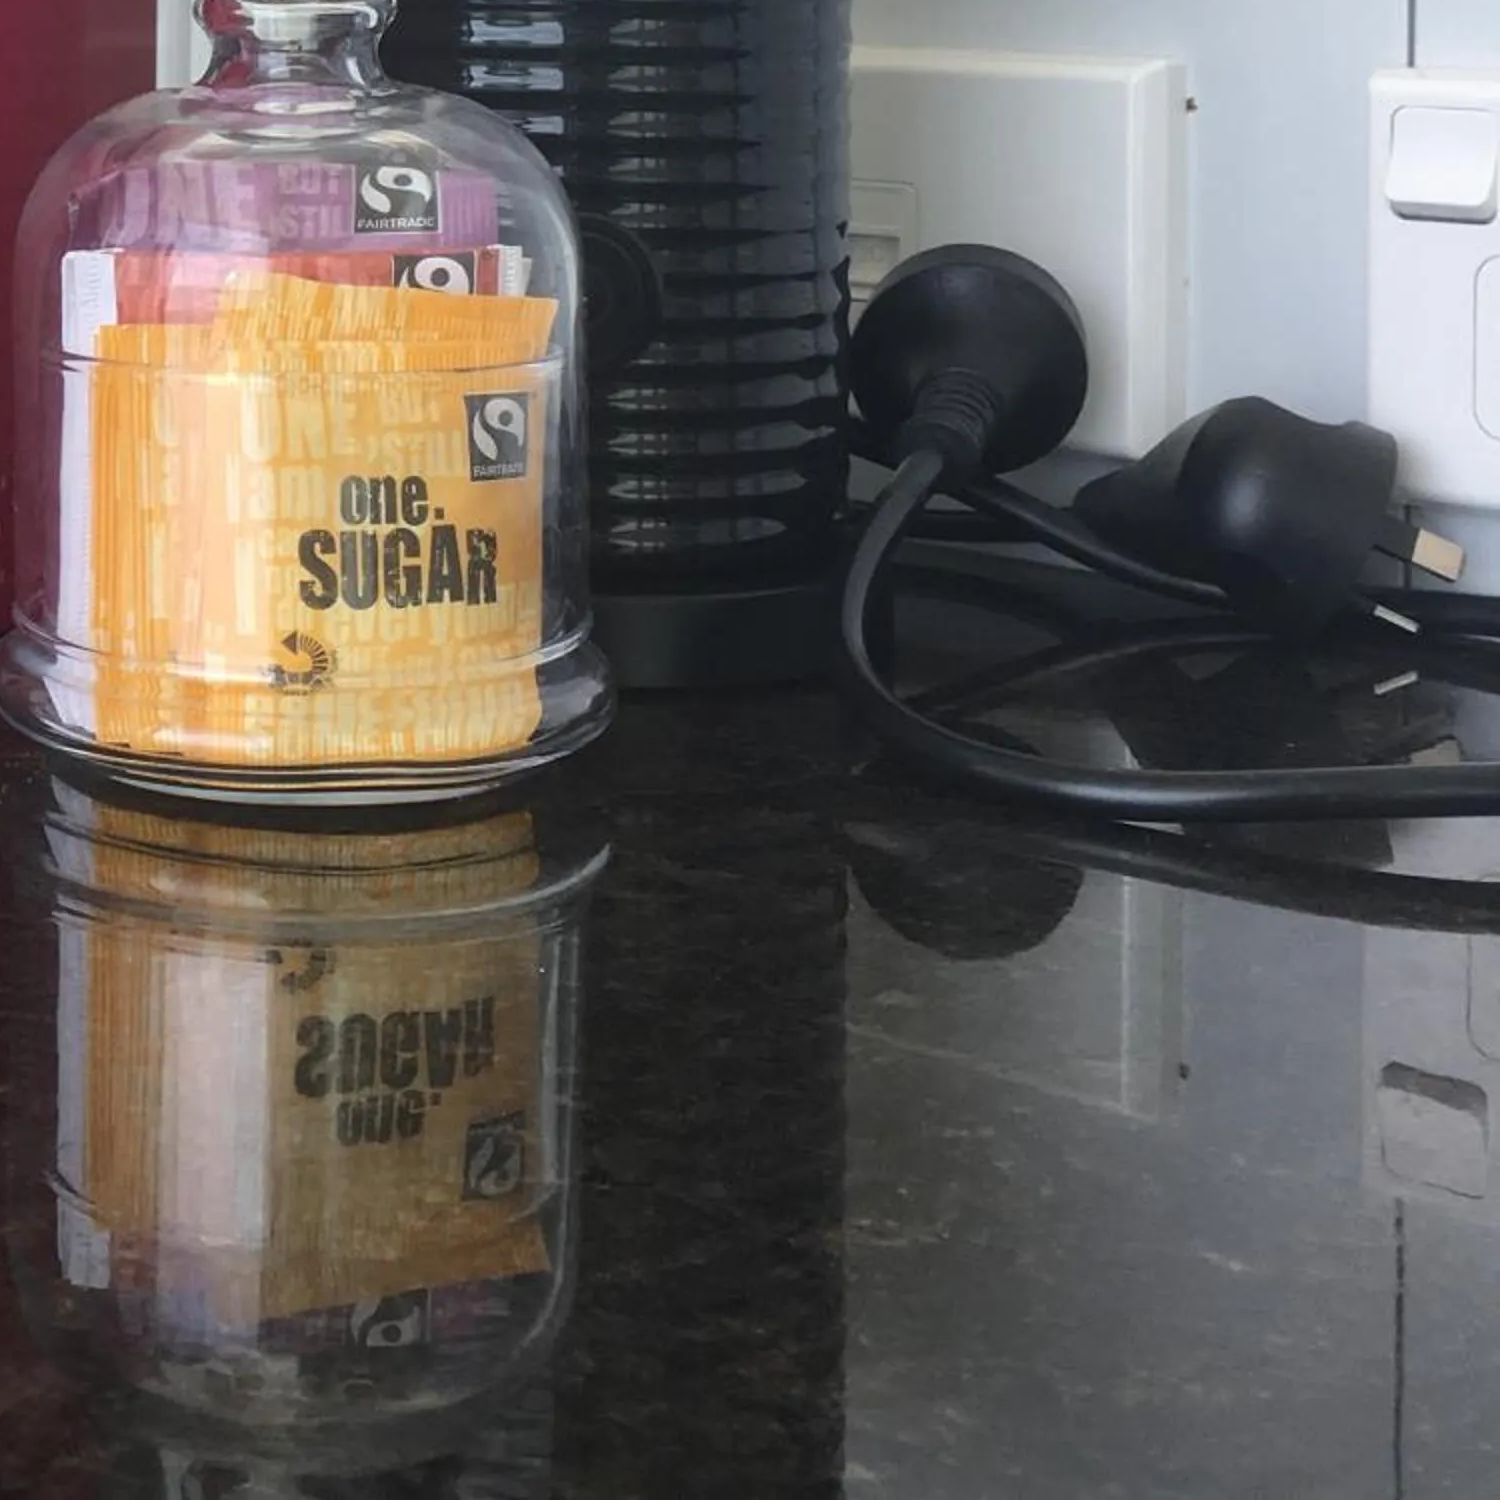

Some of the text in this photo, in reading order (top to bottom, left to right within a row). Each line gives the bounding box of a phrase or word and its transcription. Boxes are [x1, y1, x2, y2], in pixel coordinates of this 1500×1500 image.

[356, 215, 436, 230] FAIRTRADE
[339, 475, 445, 527] one.
[297, 524, 497, 611] SUGAR
